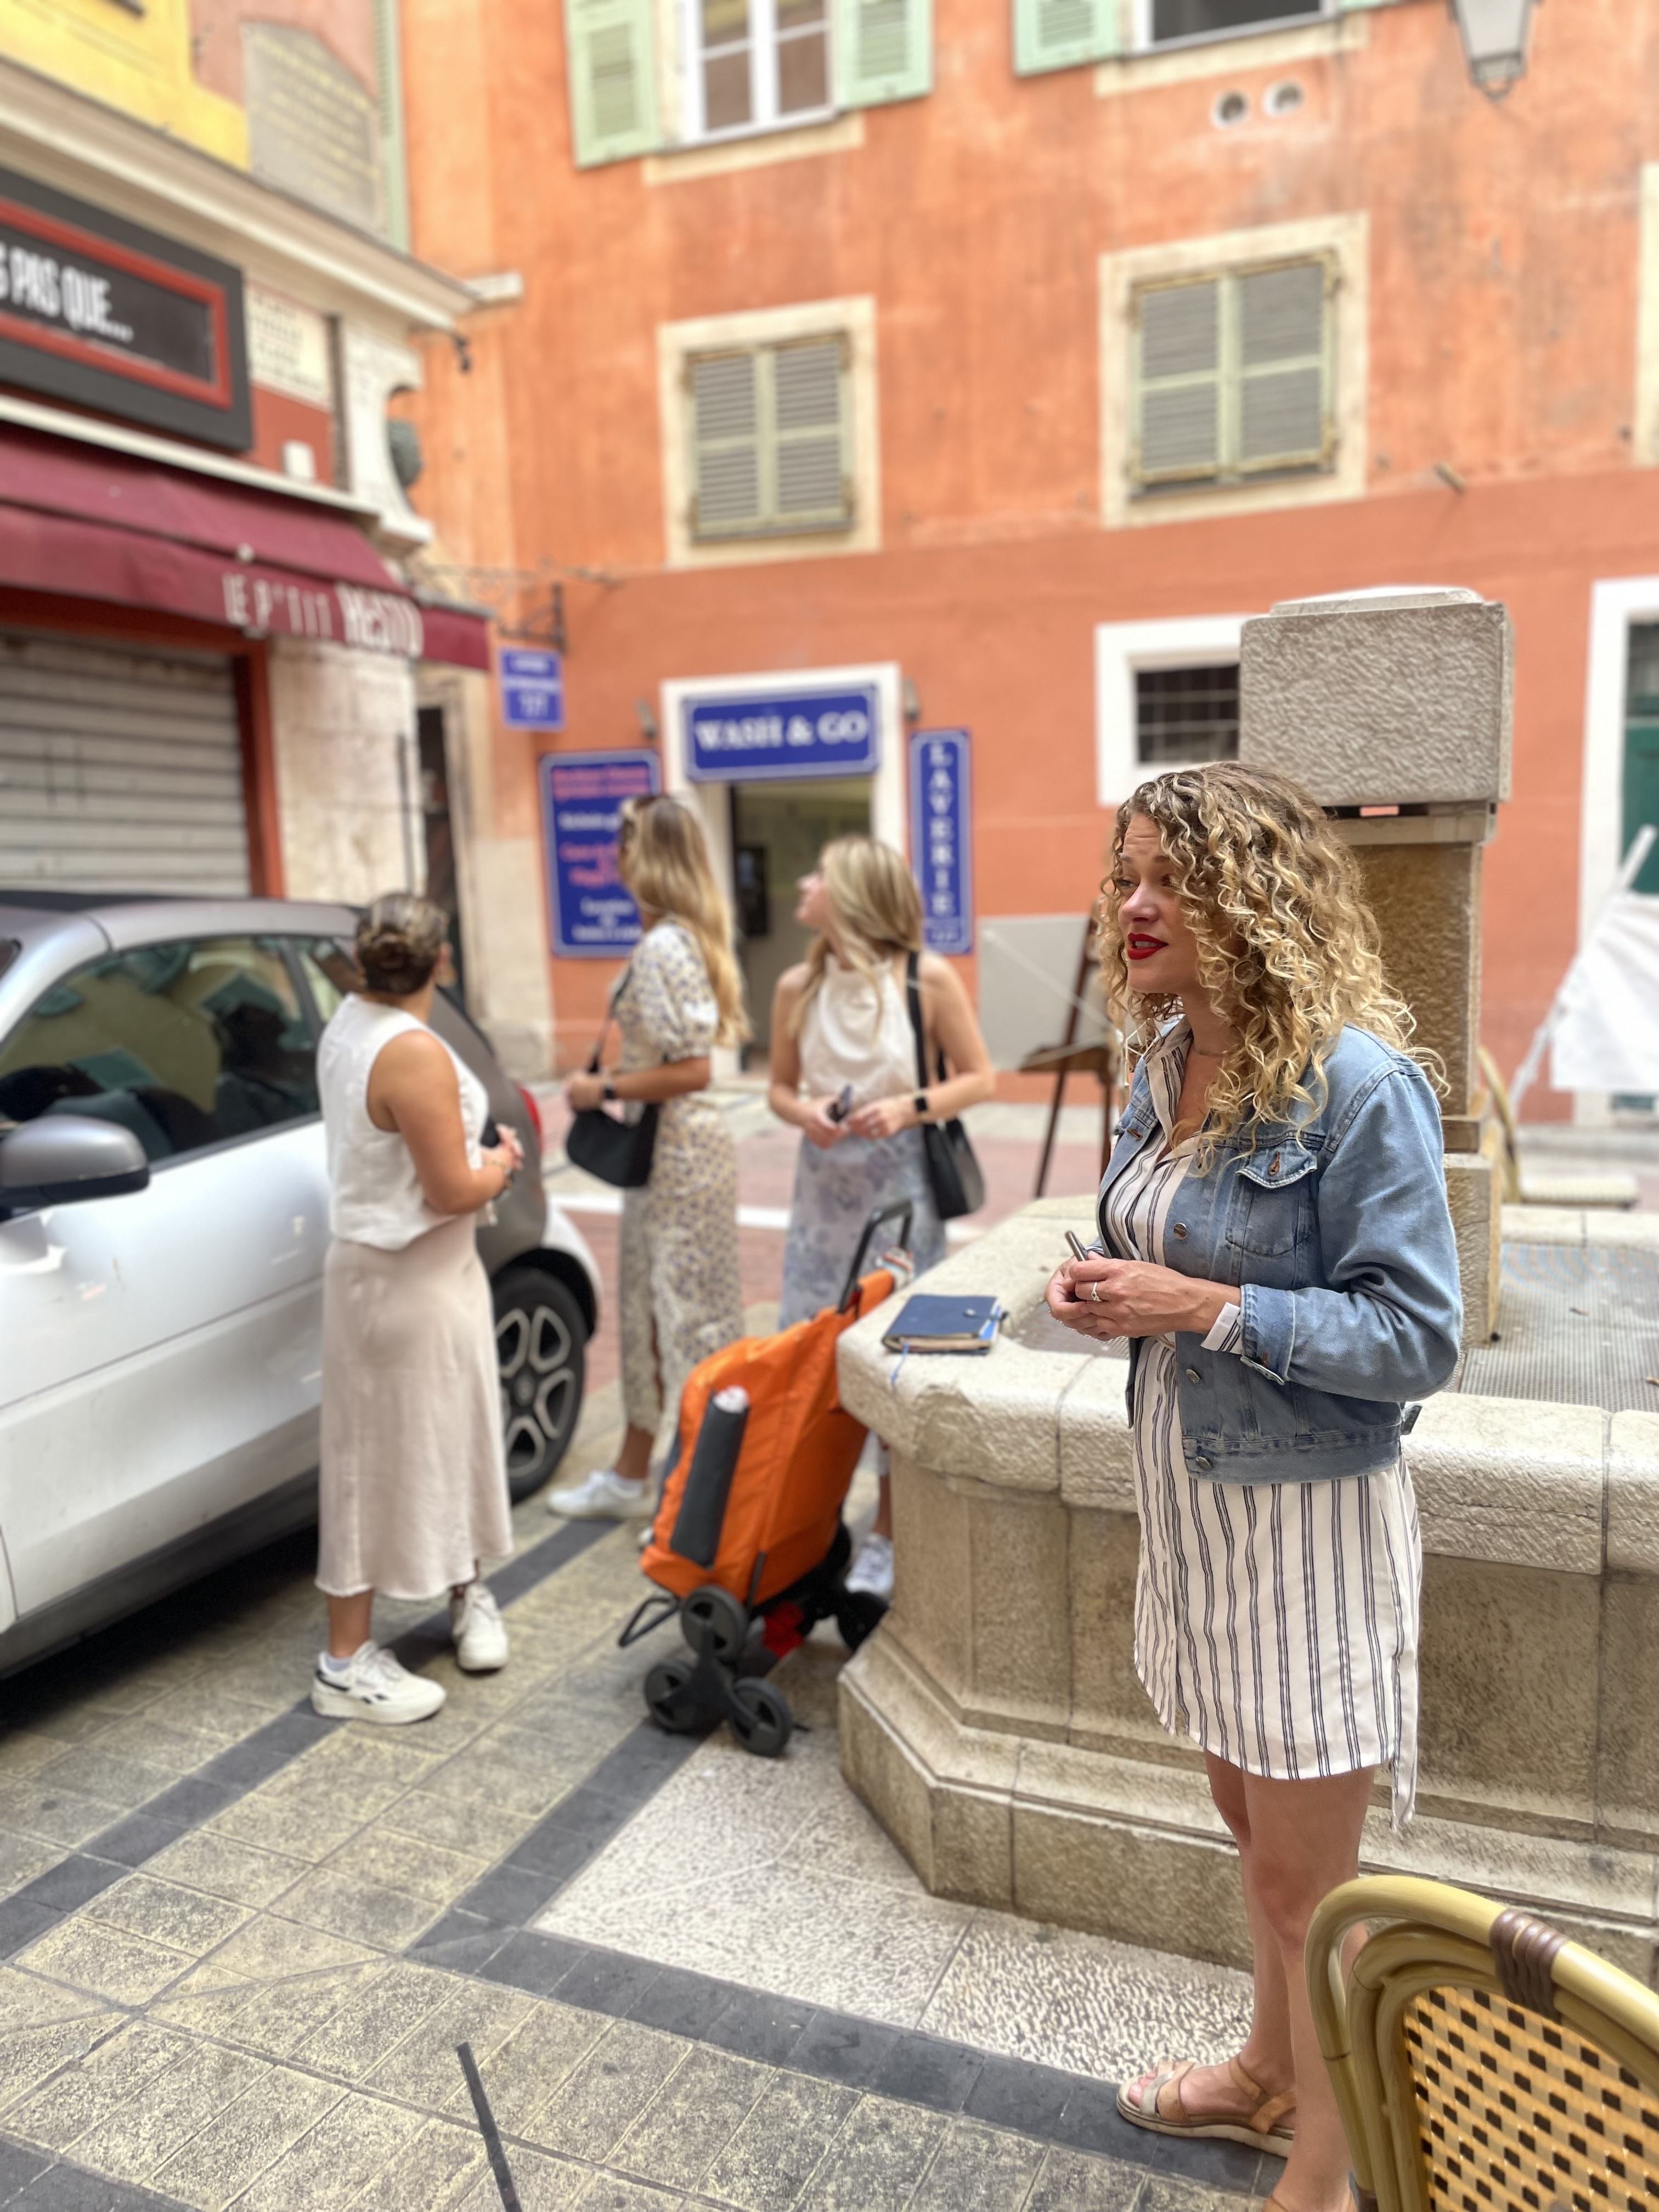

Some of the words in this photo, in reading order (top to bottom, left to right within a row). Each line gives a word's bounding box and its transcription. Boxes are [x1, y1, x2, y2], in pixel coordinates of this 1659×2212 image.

[10, 245, 61, 318] PAS
[695, 715, 783, 752] WASH
[787, 715, 816, 747] &
[929, 743, 956, 917] LAVERIE
